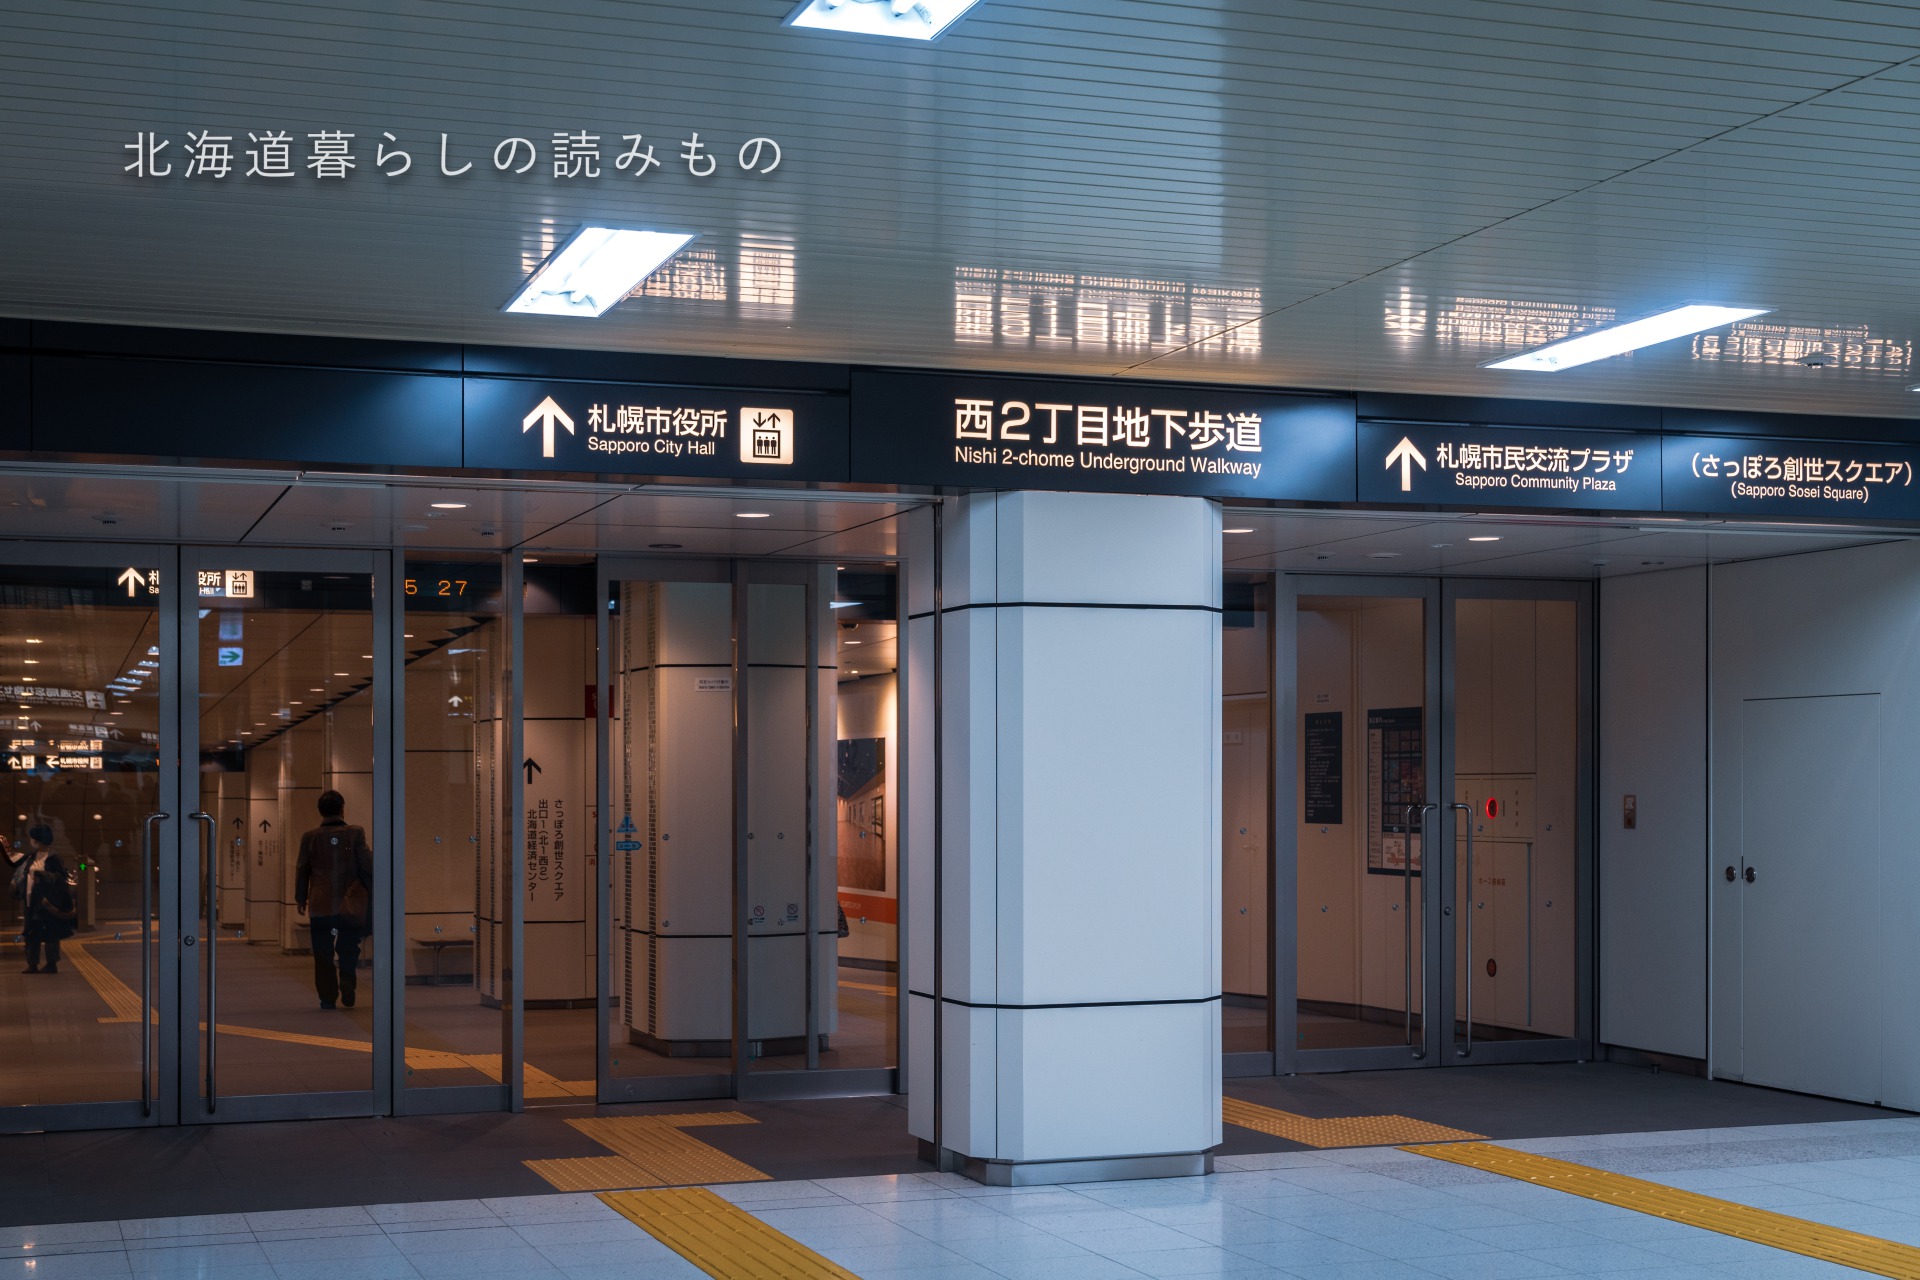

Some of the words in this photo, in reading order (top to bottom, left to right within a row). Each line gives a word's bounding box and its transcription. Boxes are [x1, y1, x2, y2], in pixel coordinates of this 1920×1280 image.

[588, 403, 727, 438] 札幌市役所
[954, 398, 1263, 453] 西2丁目地下歩道
[588, 437, 649, 455] Sapporo
[654, 439, 683, 457] City
[688, 441, 715, 456] Hall
[955, 446, 997, 464] Nishi
[1002, 448, 1075, 469] 2-chome
[1080, 451, 1185, 475] Underground
[1190, 456, 1262, 479] Walkway
[1436, 442, 1634, 474] 札幌市民交流プラザ
[1455, 472, 1507, 490] Sapporo
[1511, 474, 1579, 493] Community
[1582, 476, 1616, 491] Plaza
[1692, 452, 1912, 486] （さっぽろ創世スクエア）
[1731, 481, 1785, 500] (Sapporo
[1788, 484, 1820, 498] Sosei
[1823, 485, 1868, 503] Square)
[438, 579, 468, 596] 27
[527, 809, 538, 902] 北海道経済センター
[554, 799, 564, 902] さっぽろ創世スクエア
